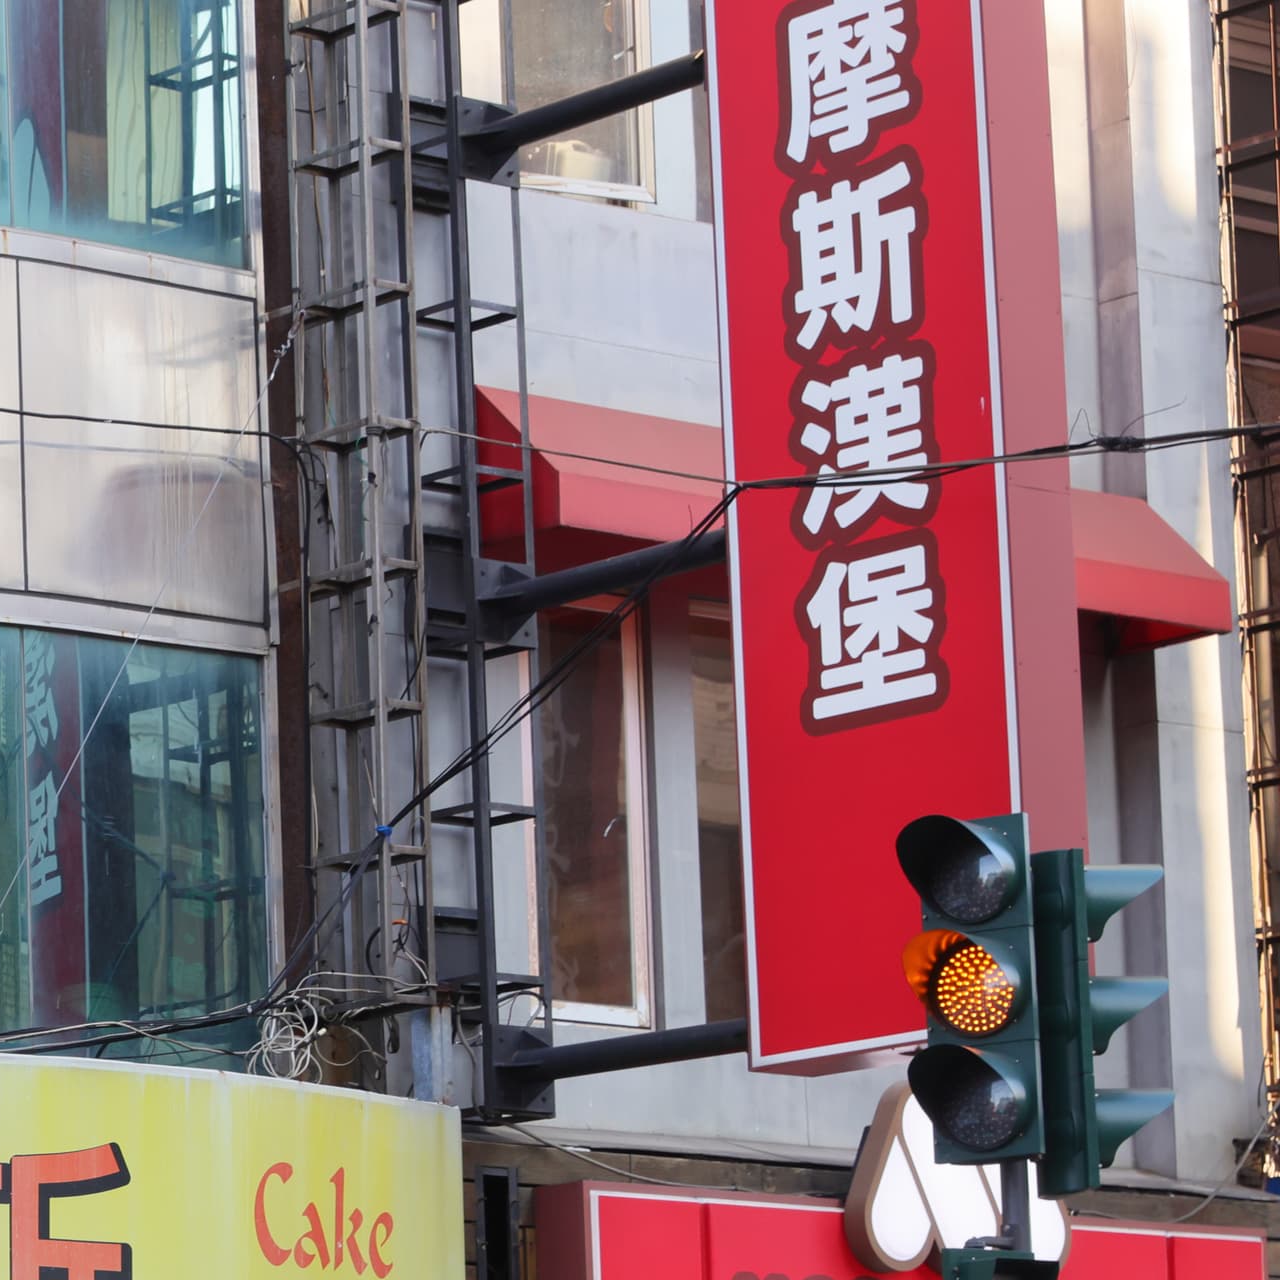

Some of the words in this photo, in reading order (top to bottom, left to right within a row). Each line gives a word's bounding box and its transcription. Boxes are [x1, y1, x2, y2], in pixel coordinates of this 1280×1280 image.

[785, 0, 938, 721] 摩斯漢堡
[253, 1161, 395, 1280] Cake
